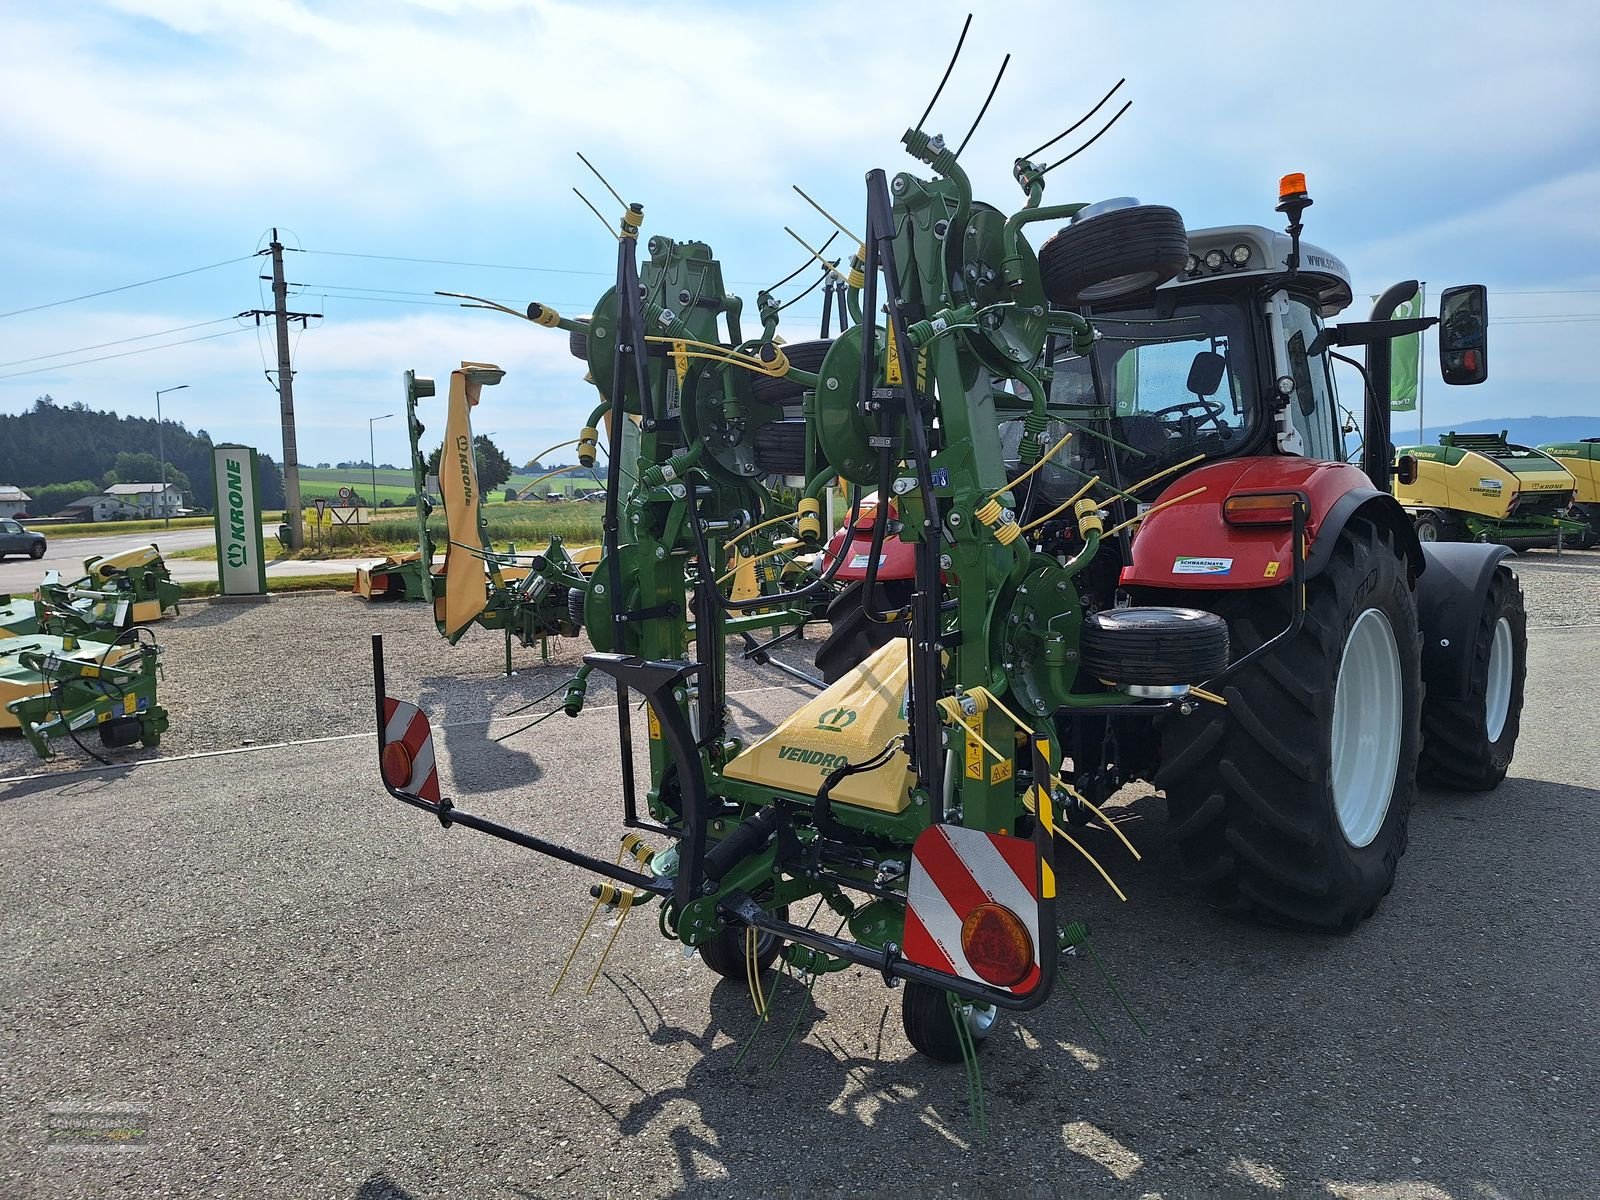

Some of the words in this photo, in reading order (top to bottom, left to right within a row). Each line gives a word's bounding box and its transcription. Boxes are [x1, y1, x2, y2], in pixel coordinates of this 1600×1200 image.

[226, 458, 246, 542] KRONE
[459, 453, 472, 507] KRONE
[778, 745, 848, 768] VENDRO
